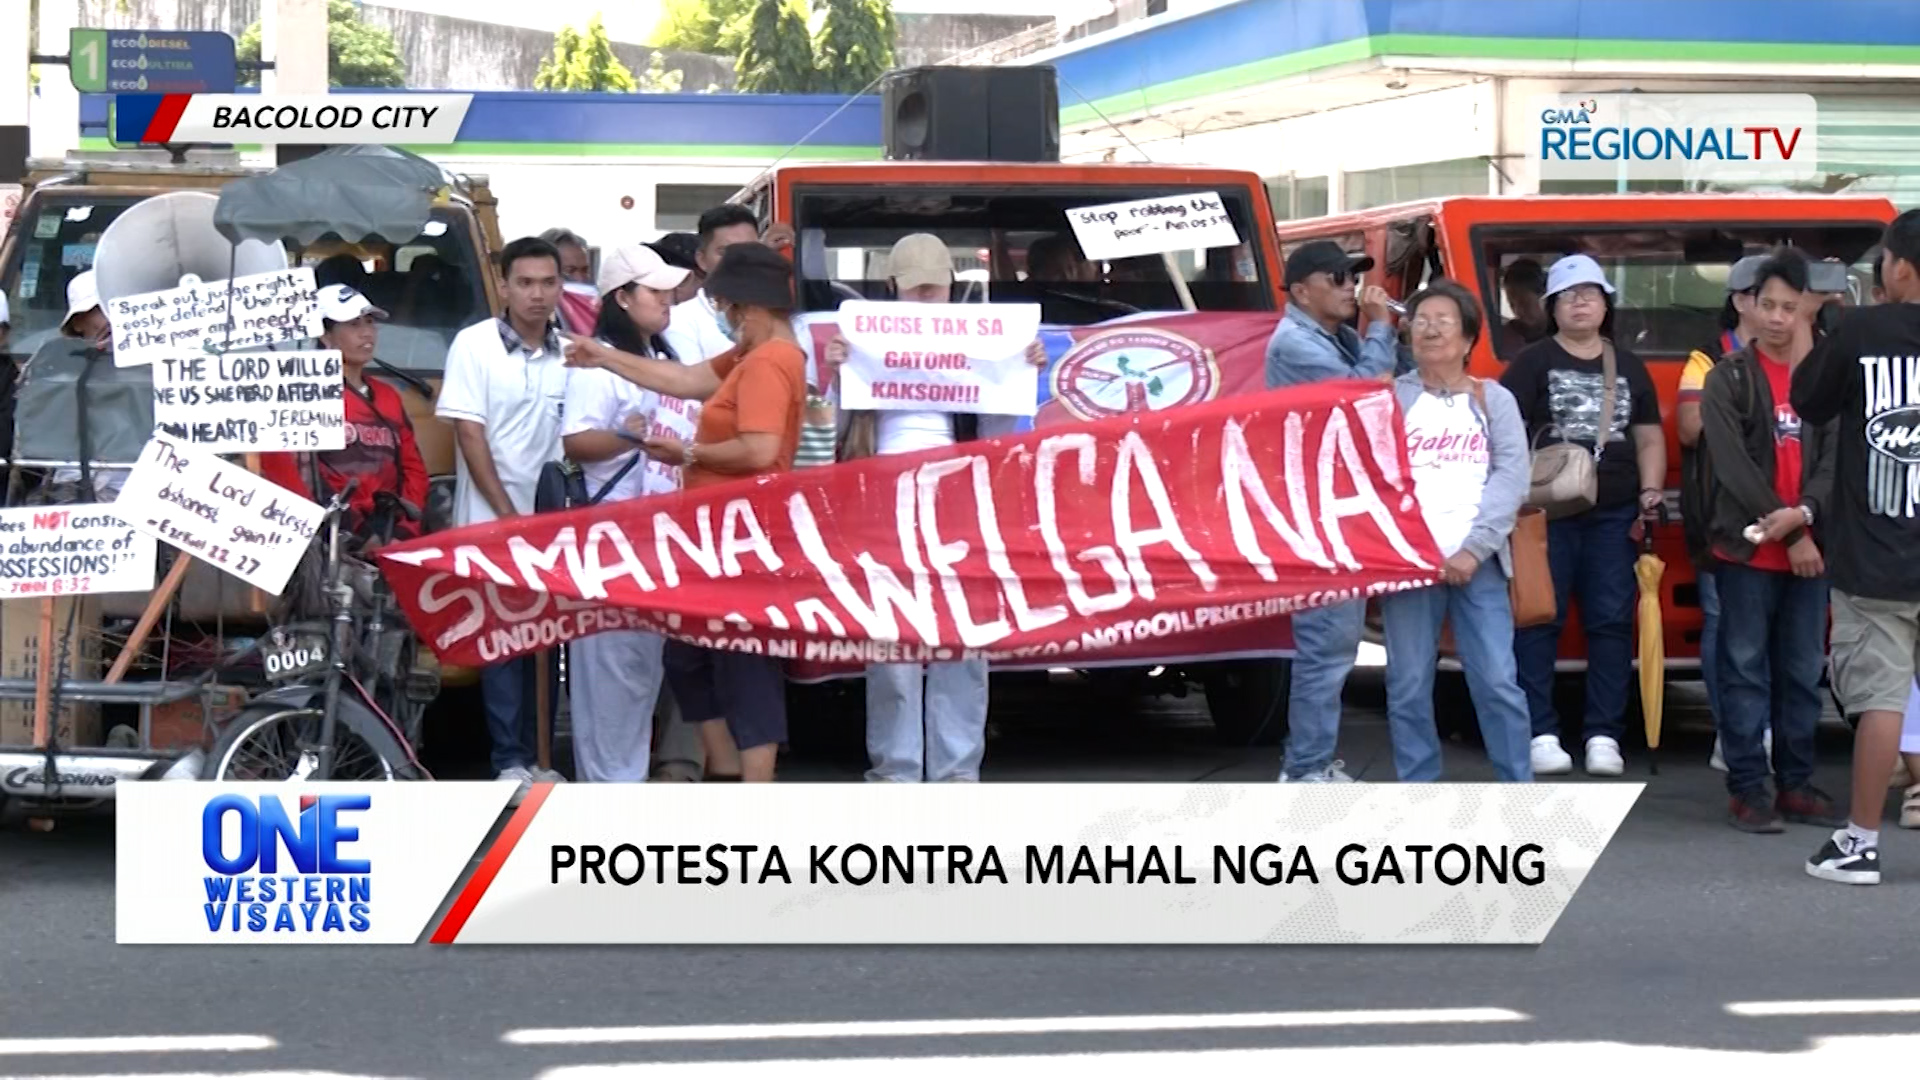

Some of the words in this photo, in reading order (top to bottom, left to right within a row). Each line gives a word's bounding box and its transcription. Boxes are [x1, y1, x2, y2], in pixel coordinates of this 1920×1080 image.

[79, 40, 99, 80] 1
[1190, 198, 1220, 211] the
[855, 315, 923, 334] EXCISE
[931, 317, 968, 336] TAX
[977, 318, 1003, 336] SA
[162, 358, 206, 382] THE
[219, 357, 270, 382] LORD
[277, 357, 322, 377] WILL
[179, 386, 200, 406] US
[871, 381, 980, 403] KAKSON!!!
[156, 439, 189, 474] The
[208, 471, 256, 507] Lord
[33, 511, 70, 531] NOT
[652, 498, 784, 589] NA
[788, 431, 1218, 648] WELGA
[1220, 389, 1438, 584] NA!
[9, 534, 105, 554] abundance
[112, 530, 136, 550] of
[477, 614, 574, 662] UNDOC
[768, 638, 797, 658] NI
